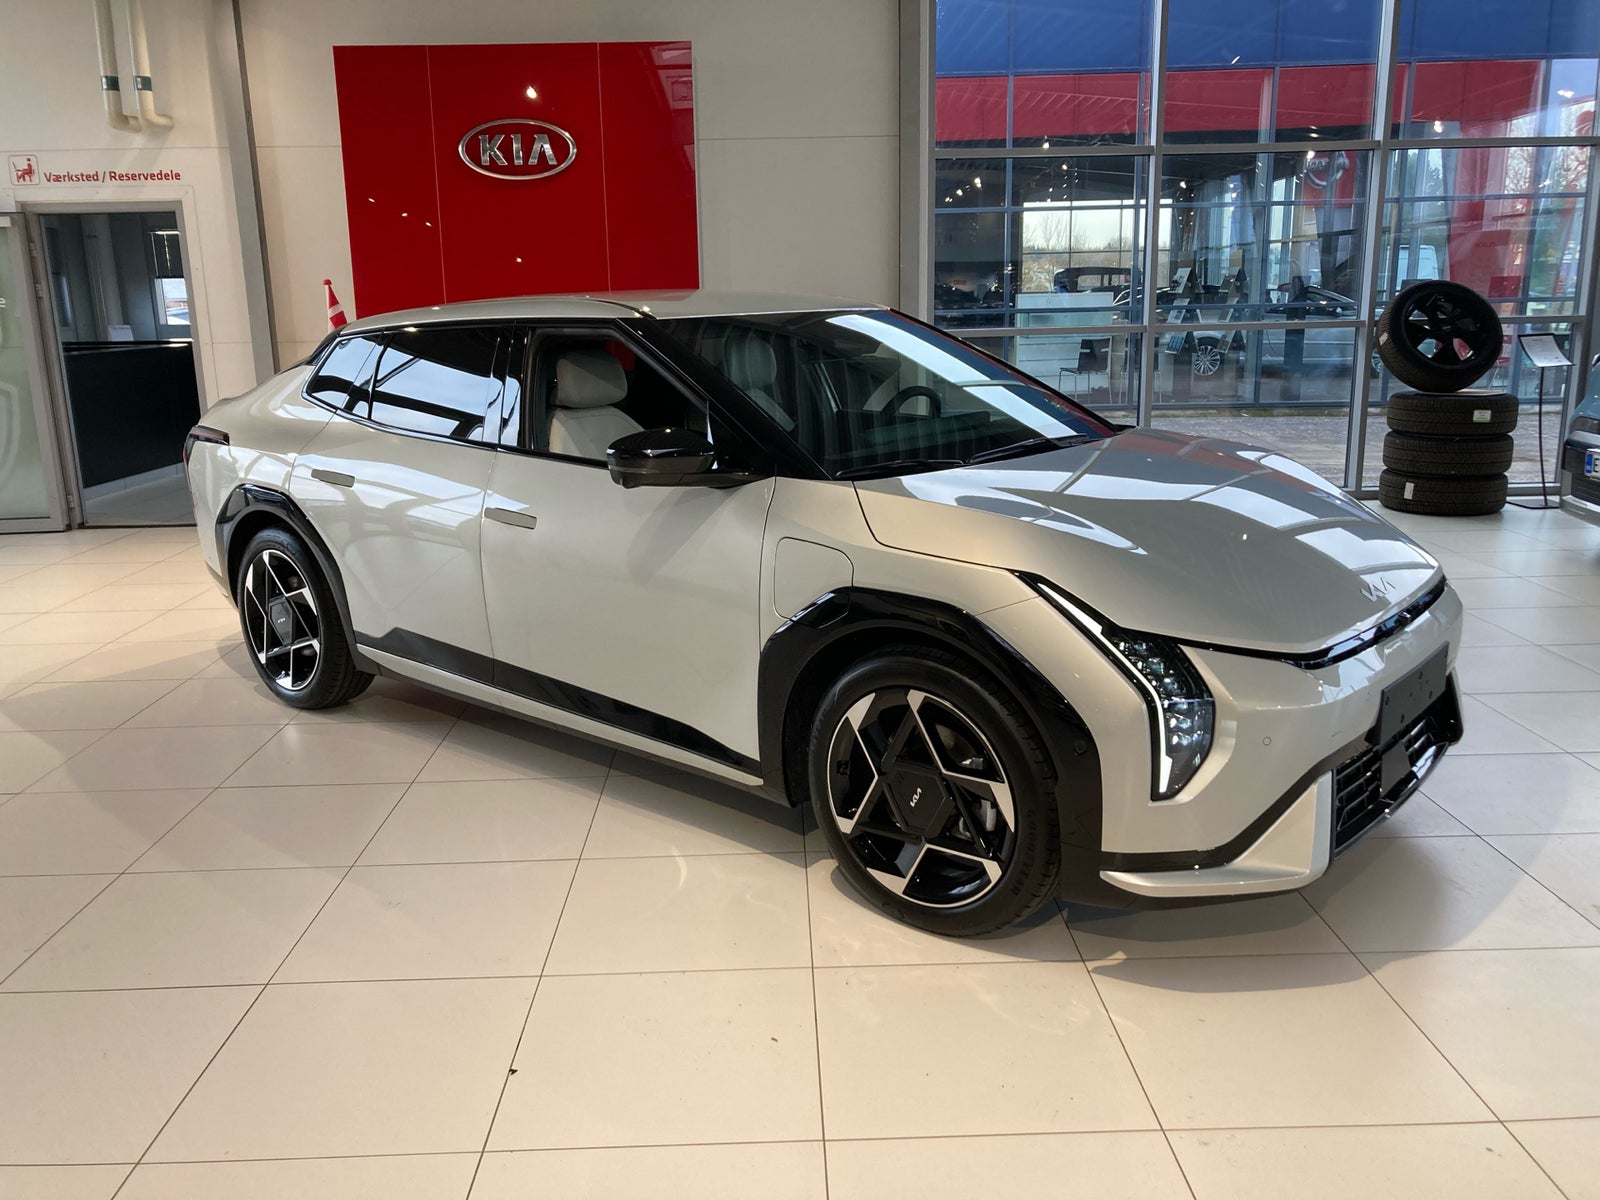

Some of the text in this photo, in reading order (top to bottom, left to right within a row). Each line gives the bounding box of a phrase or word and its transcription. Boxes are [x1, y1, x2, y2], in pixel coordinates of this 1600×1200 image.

[478, 133, 558, 166] KIA
[43, 169, 181, 183] Værksted / Reservedele
